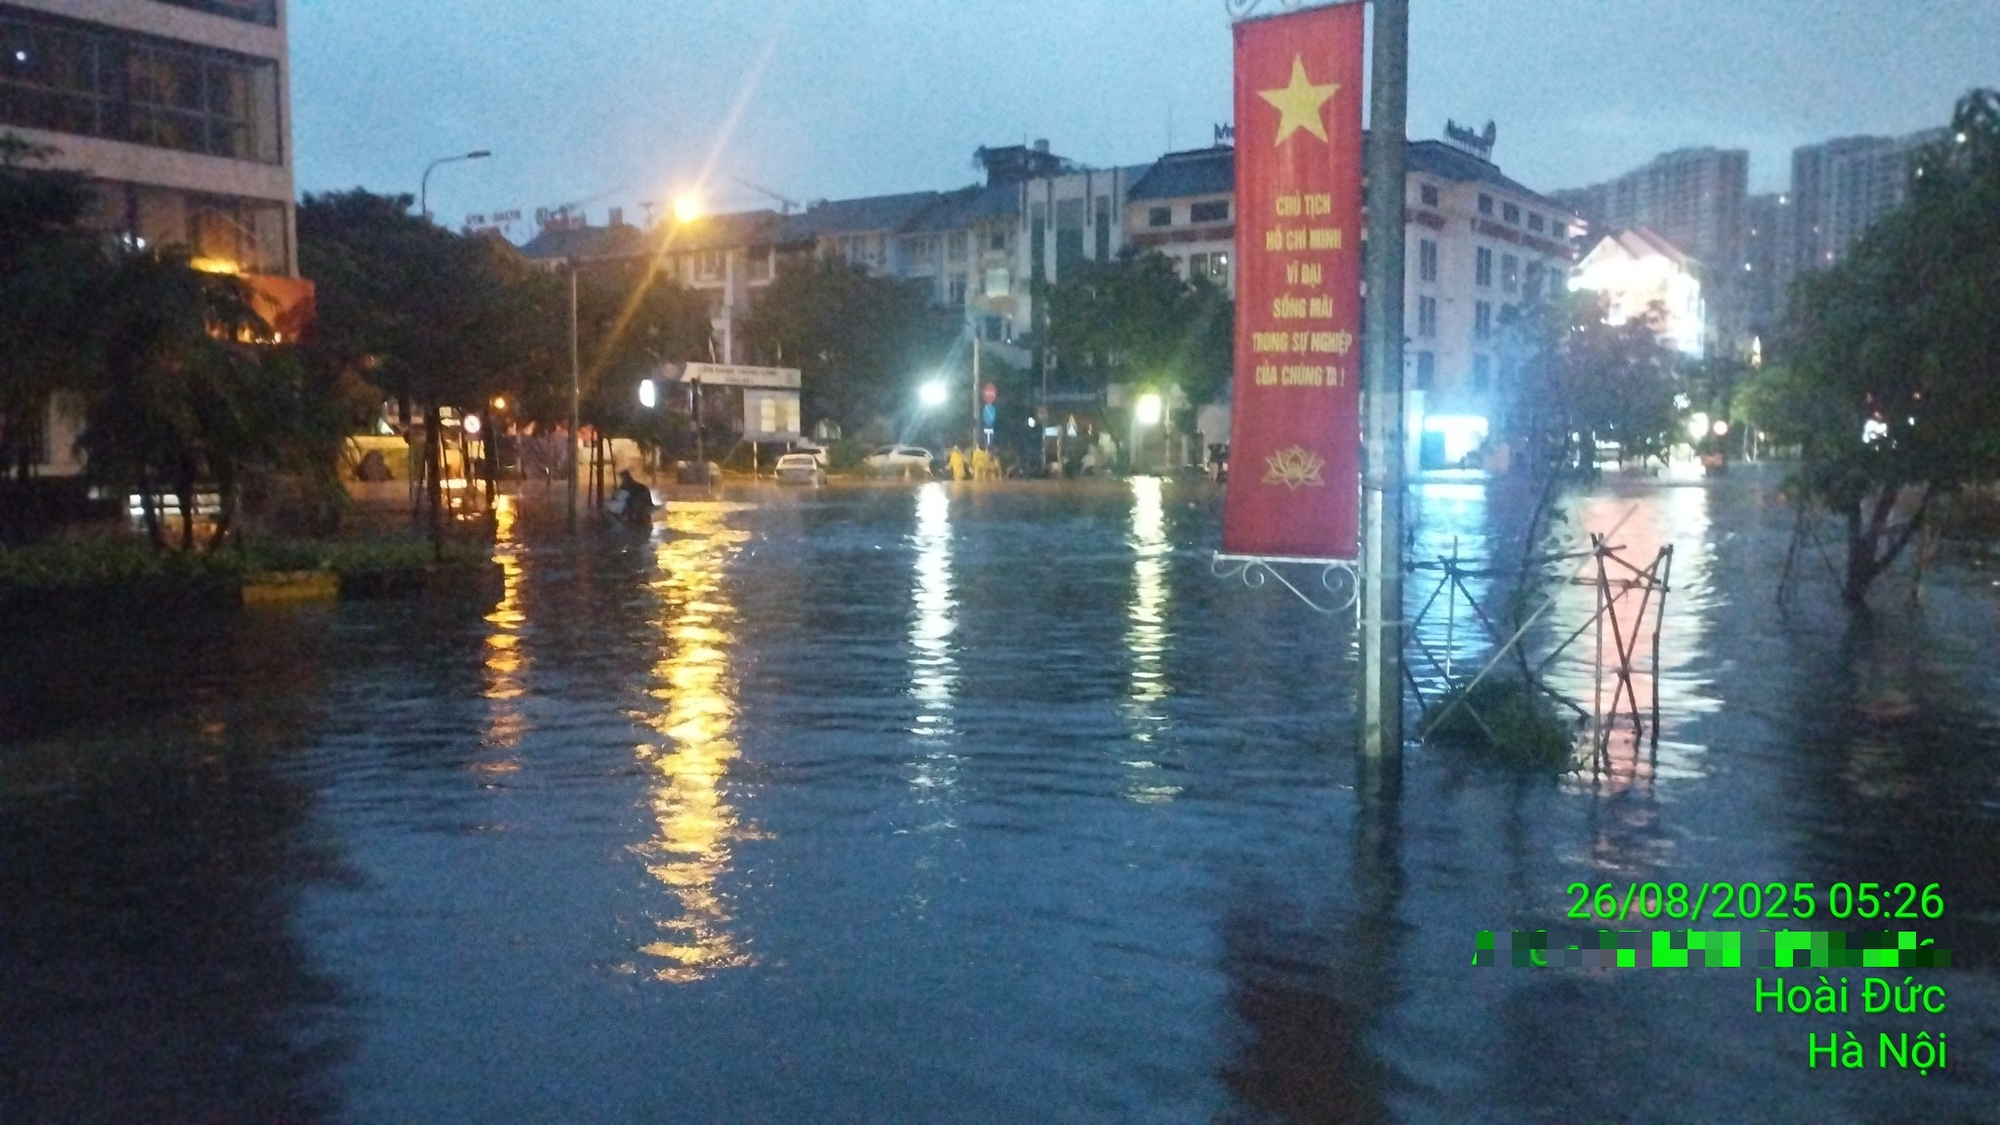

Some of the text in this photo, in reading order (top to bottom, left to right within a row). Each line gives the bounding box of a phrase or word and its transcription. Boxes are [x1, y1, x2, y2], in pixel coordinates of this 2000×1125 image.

[1275, 187, 1331, 220] CHỦ TỊCH
[1265, 224, 1342, 251] HỒ CHÍ MINH
[1286, 260, 1321, 288] VĨ ĐẠI
[1273, 291, 1334, 319] SỐNG MÃI
[1253, 329, 1353, 357] TRONG SỰ NGHIỆP
[1256, 359, 1278, 386] CỦA
[1282, 362, 1323, 387] CHÚNG
